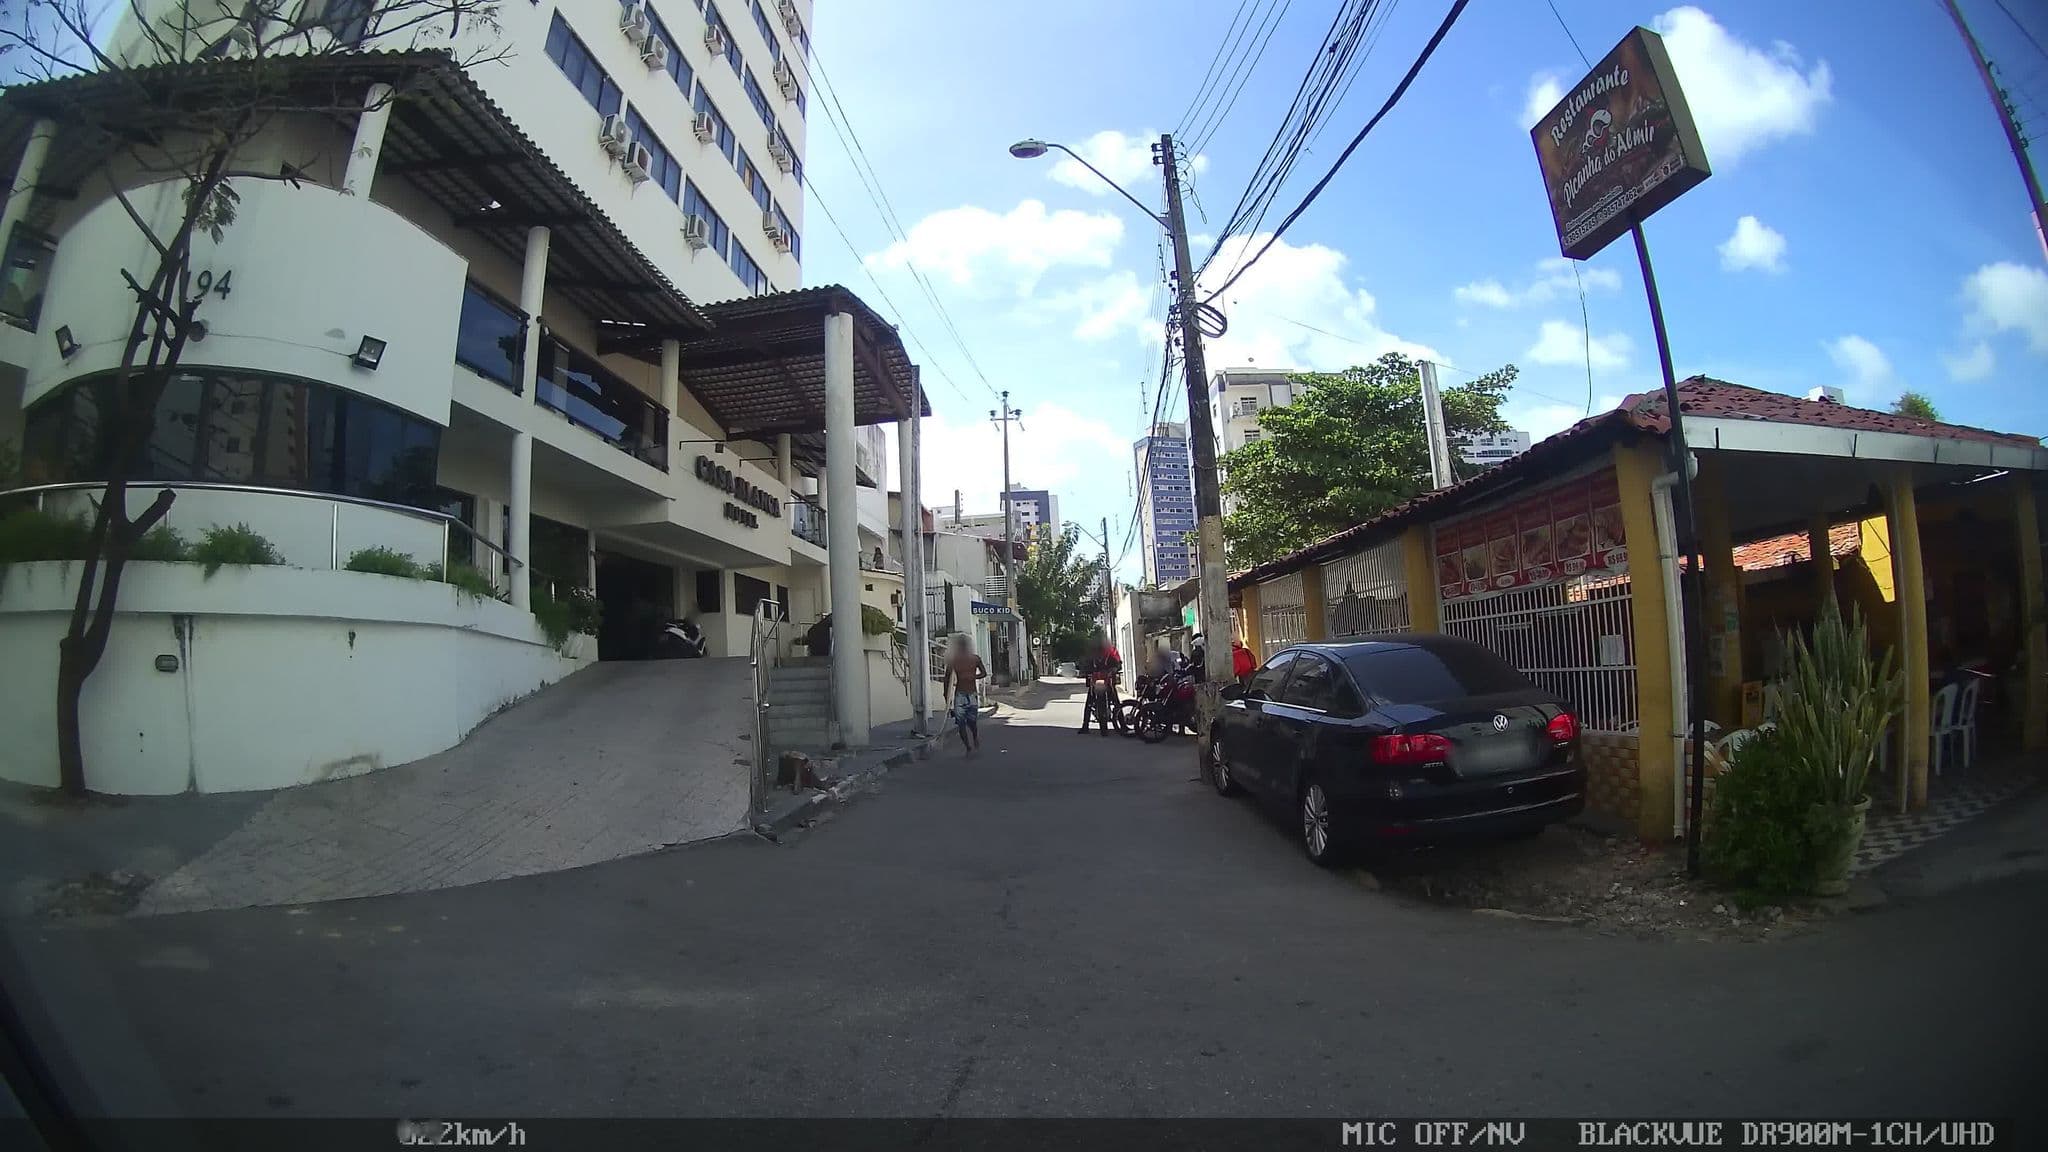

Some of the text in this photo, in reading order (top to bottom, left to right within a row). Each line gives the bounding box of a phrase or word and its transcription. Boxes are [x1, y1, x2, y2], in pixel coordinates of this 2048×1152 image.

[1551, 64, 1629, 146] Restaurante
[1563, 155, 1602, 209] Picanha
[1604, 147, 1616, 168] do
[1616, 120, 1656, 159] Almir
